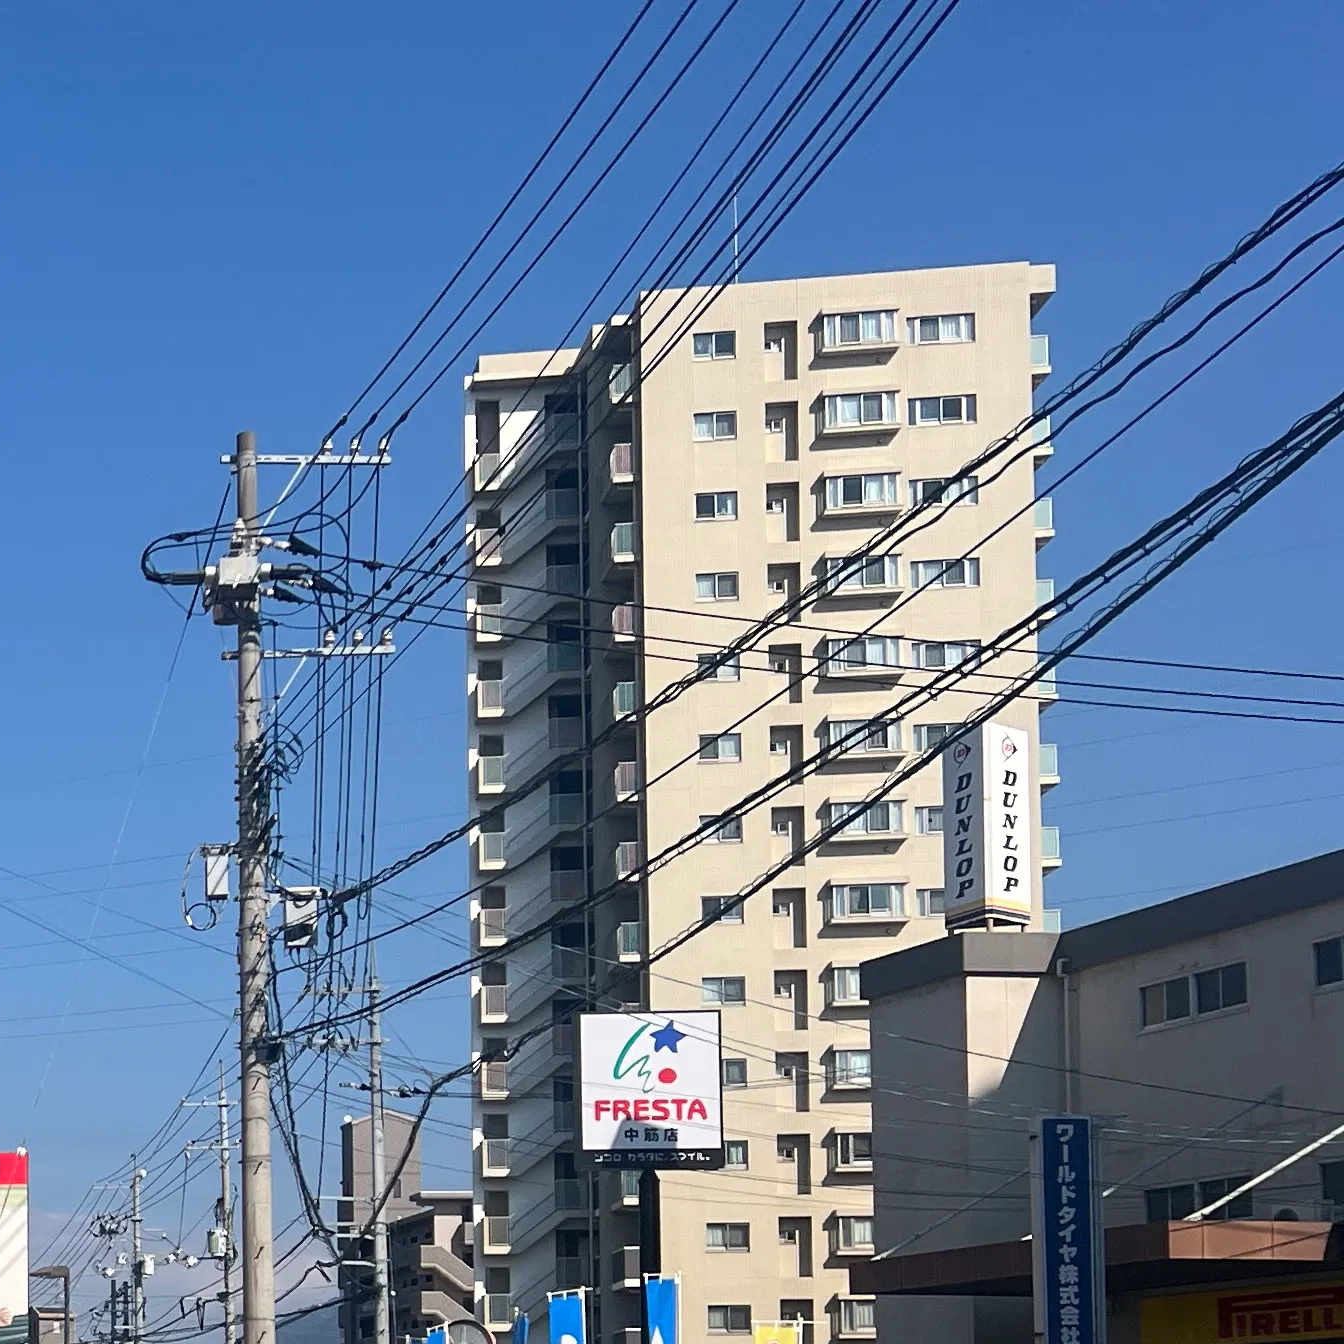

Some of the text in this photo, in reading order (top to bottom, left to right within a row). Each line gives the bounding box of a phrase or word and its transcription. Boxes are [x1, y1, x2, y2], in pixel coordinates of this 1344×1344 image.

[954, 771, 974, 899] DUNLOP
[1002, 769, 1019, 892] DUNLOP
[594, 1098, 708, 1121] FRESTA
[624, 1127, 679, 1143] 中筋店
